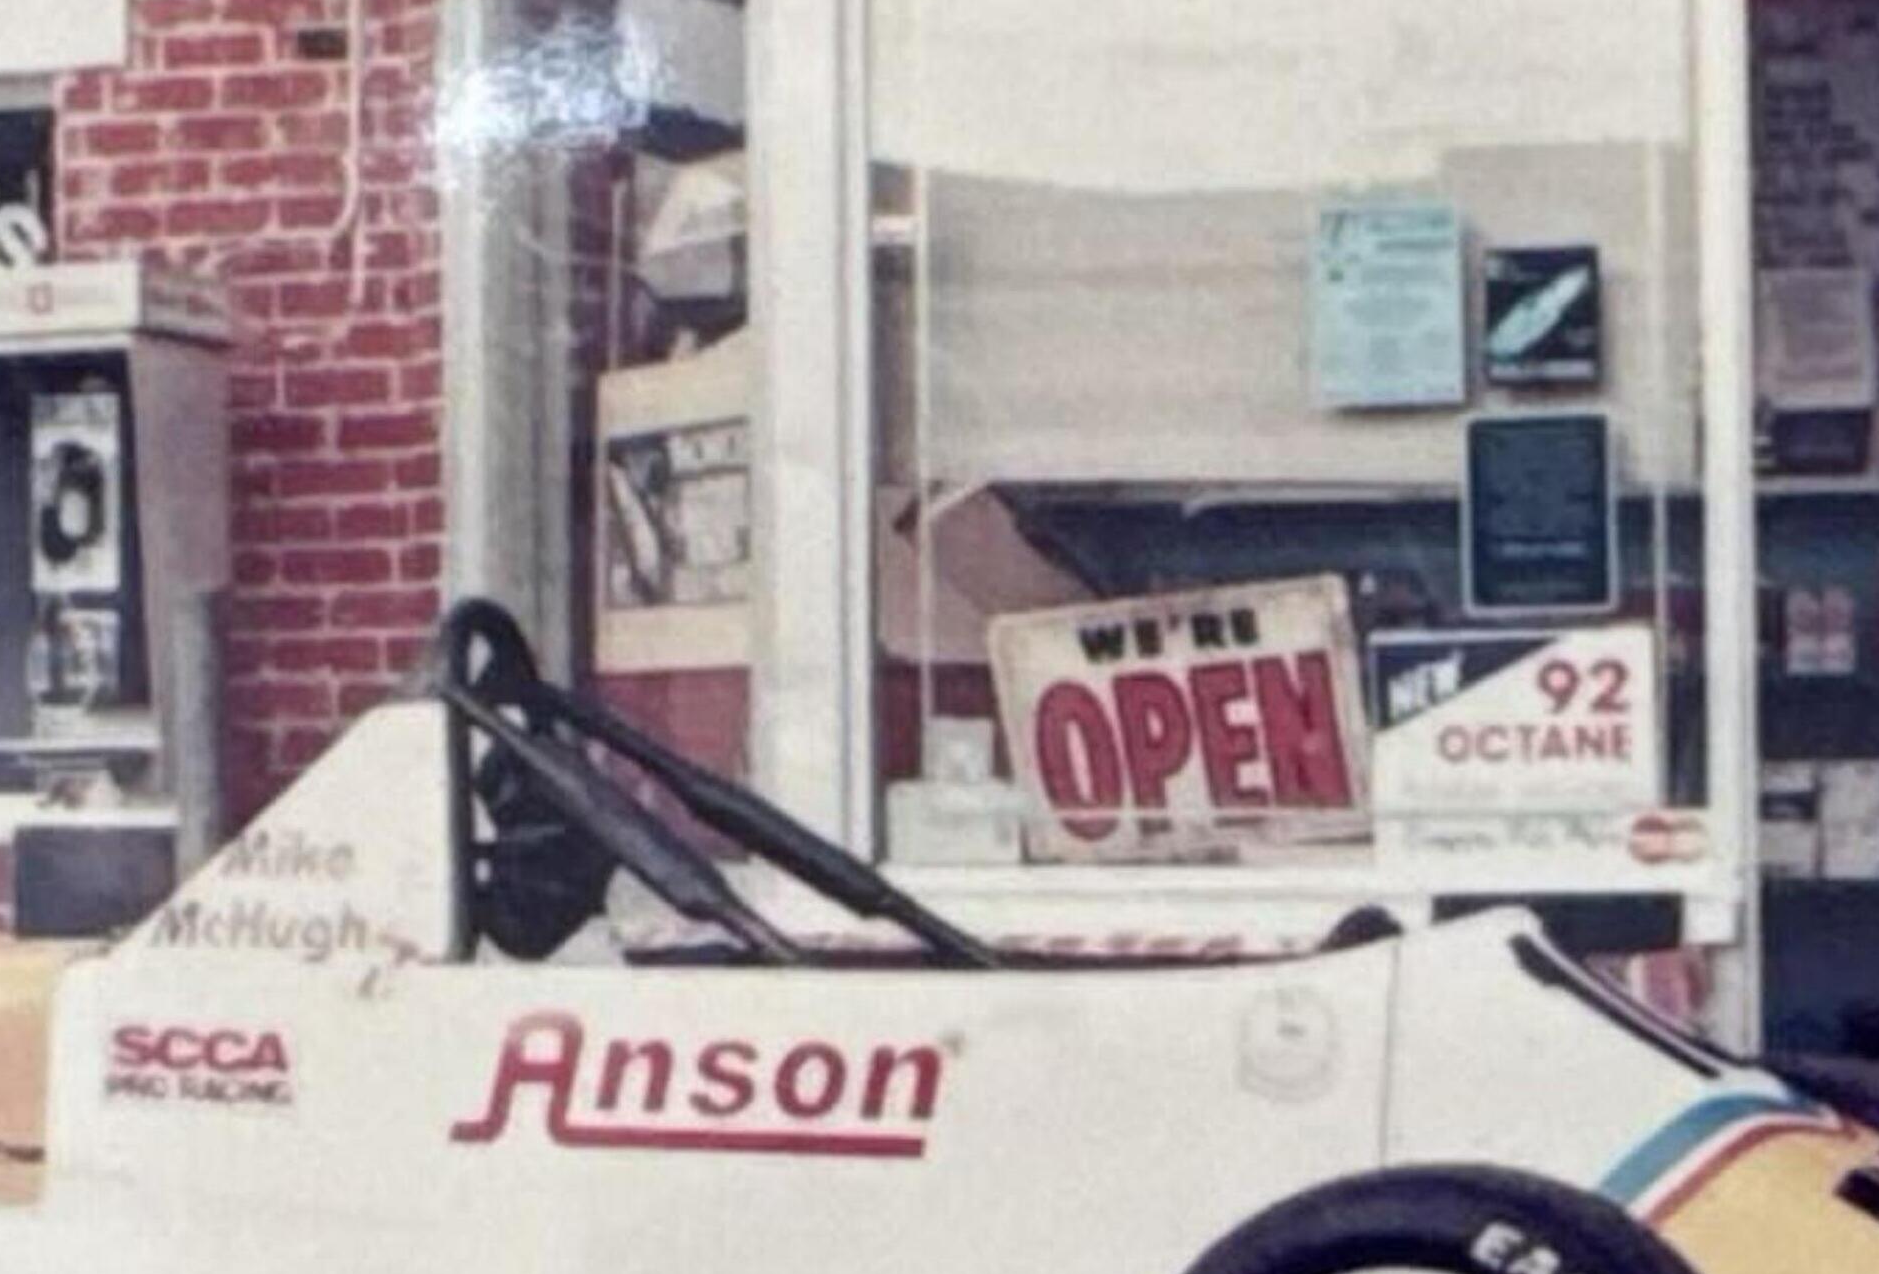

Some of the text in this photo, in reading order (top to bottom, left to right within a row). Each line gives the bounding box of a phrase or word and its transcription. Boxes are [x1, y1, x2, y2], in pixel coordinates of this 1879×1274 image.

[1079, 608, 1258, 664] WE'RE
[1536, 659, 1630, 714] 92
[1036, 648, 1354, 842] OPEN
[1438, 724, 1632, 763] OCTANE
[222, 828, 356, 876] Mike
[113, 1026, 289, 1073] SCCA
[449, 1008, 947, 1157] Anson
